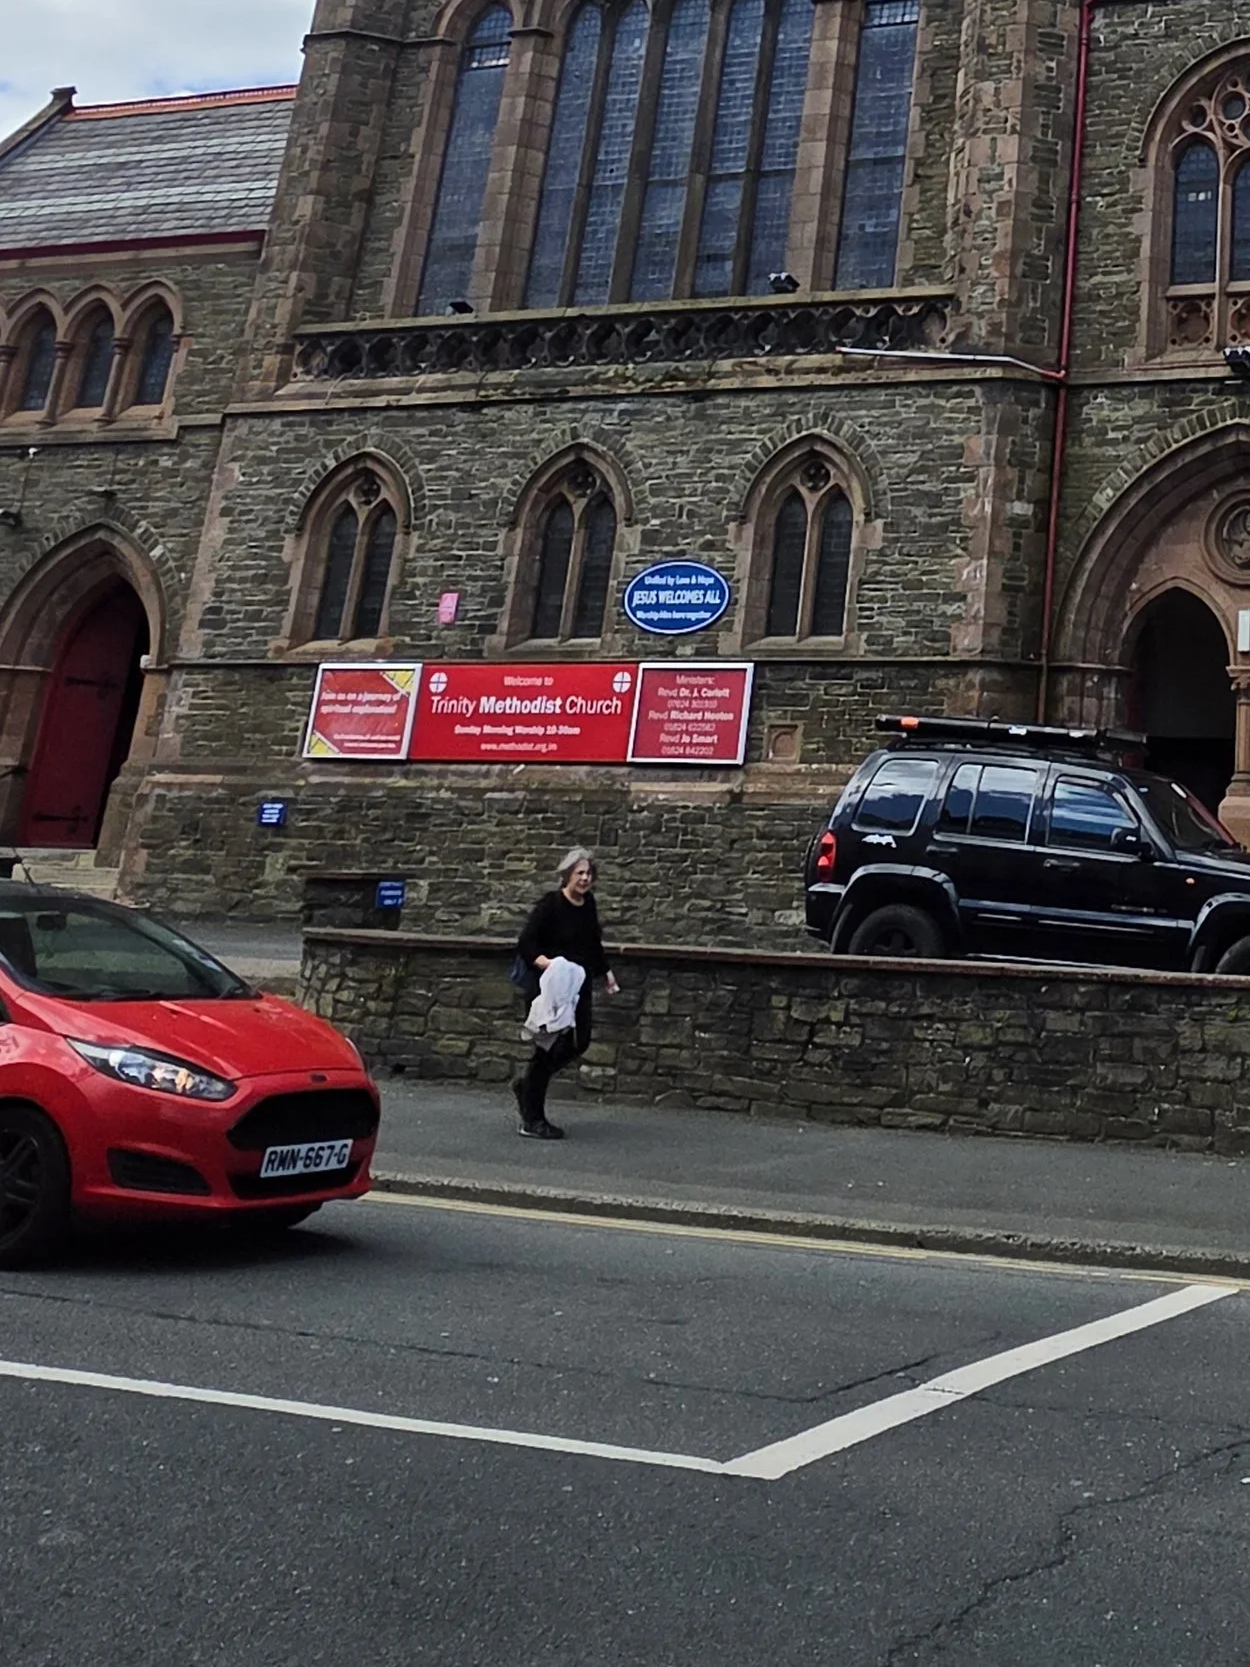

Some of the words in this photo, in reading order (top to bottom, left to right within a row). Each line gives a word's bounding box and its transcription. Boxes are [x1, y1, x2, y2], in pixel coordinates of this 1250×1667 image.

[631, 590, 657, 607] JESUS
[658, 590, 705, 604] WELCOMES
[704, 590, 721, 604] ALL
[504, 676, 543, 686] Welcome
[544, 676, 554, 686] to
[320, 690, 337, 701] Join
[337, 692, 346, 701] us
[346, 692, 357, 701] on
[363, 692, 391, 703] journey
[657, 687, 679, 697] Revd
[679, 687, 691, 697] Dr.
[431, 696, 476, 717] Trinity
[479, 696, 562, 715] Methodist
[565, 696, 622, 715] Church
[648, 710, 669, 720] Revd
[670, 710, 703, 721] Richard
[454, 724, 481, 736] Sunday
[482, 724, 514, 736] Morning
[515, 725, 545, 736] Worship
[659, 733, 681, 743] Revd
[681, 733, 691, 743] Jo
[692, 734, 718, 744] Smart
